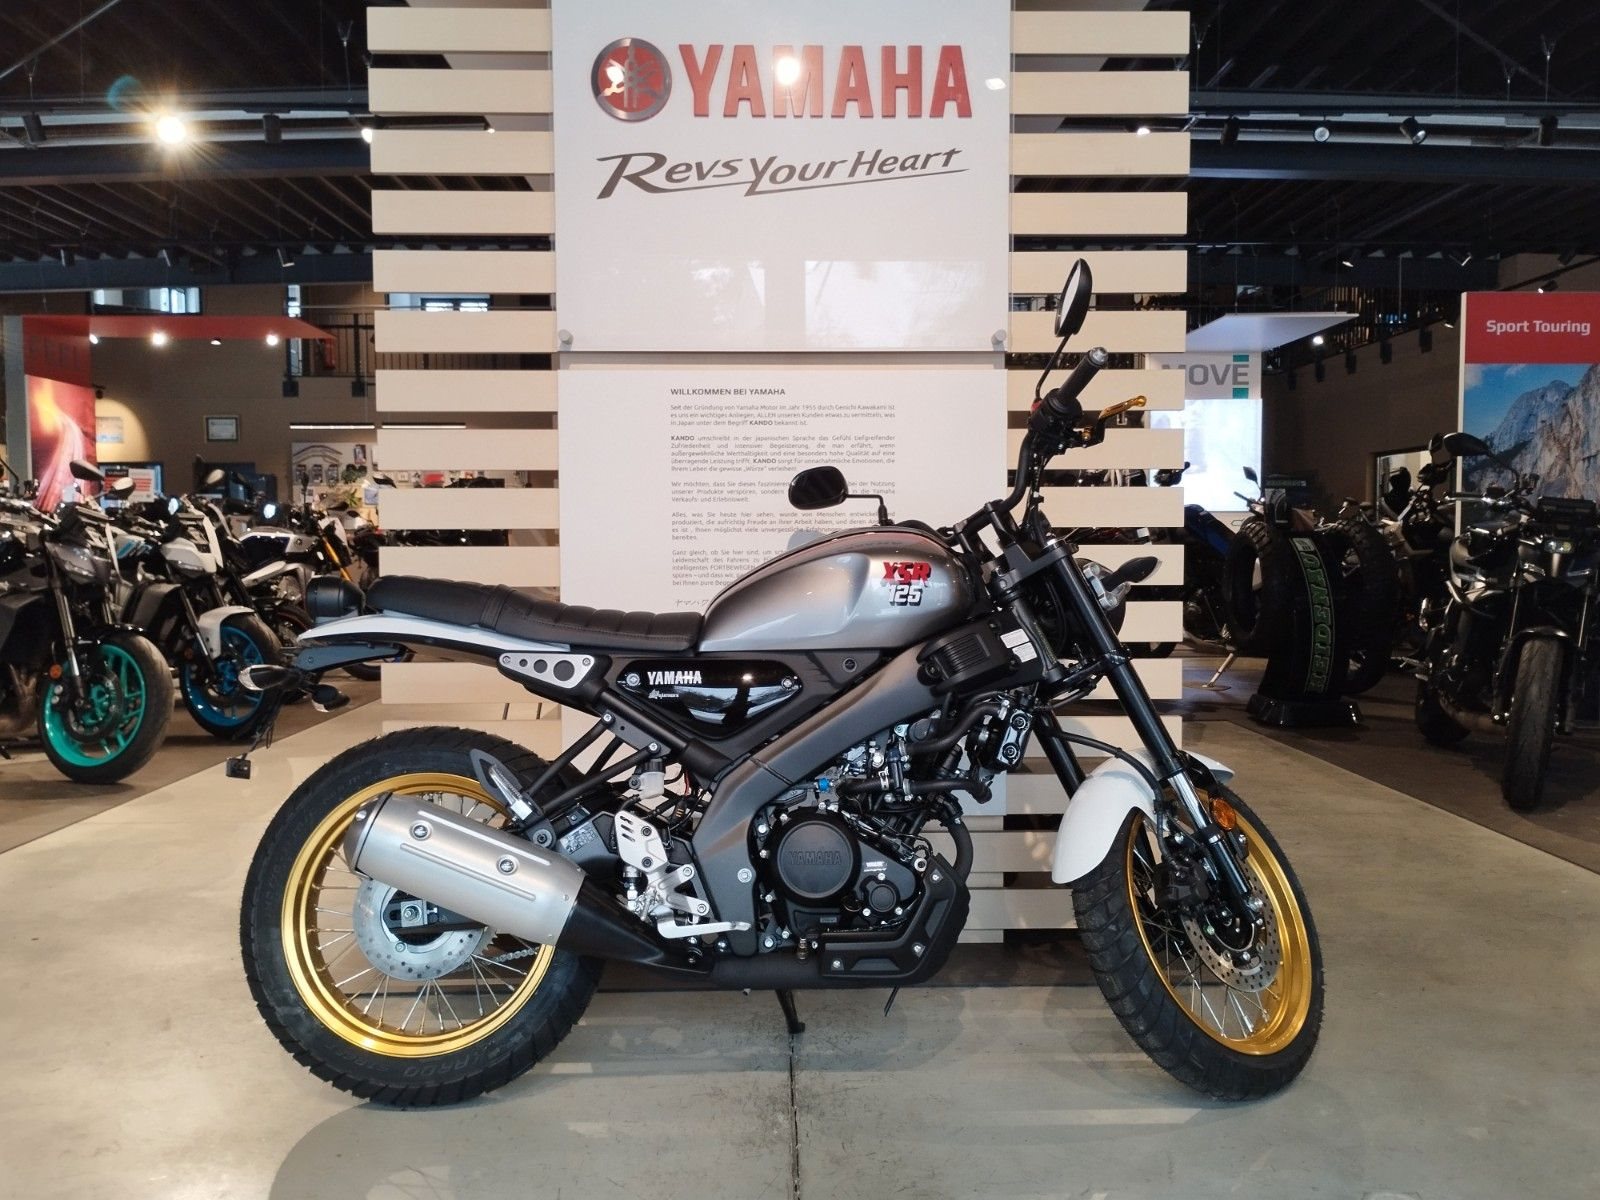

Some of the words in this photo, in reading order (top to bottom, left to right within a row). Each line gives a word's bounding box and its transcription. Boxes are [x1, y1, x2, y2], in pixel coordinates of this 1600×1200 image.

[678, 44, 972, 118] YAMAHA
[596, 152, 744, 200] Revs
[744, 156, 850, 197] Your
[853, 148, 962, 178] Heart
[1486, 320, 1530, 336] Sport
[1533, 320, 1591, 336] Touring
[1162, 364, 1250, 386] OVE
[883, 562, 932, 587] XSR
[888, 584, 923, 606] 125
[647, 670, 702, 685] YAMAHA
[788, 850, 842, 866] YAMAHA
